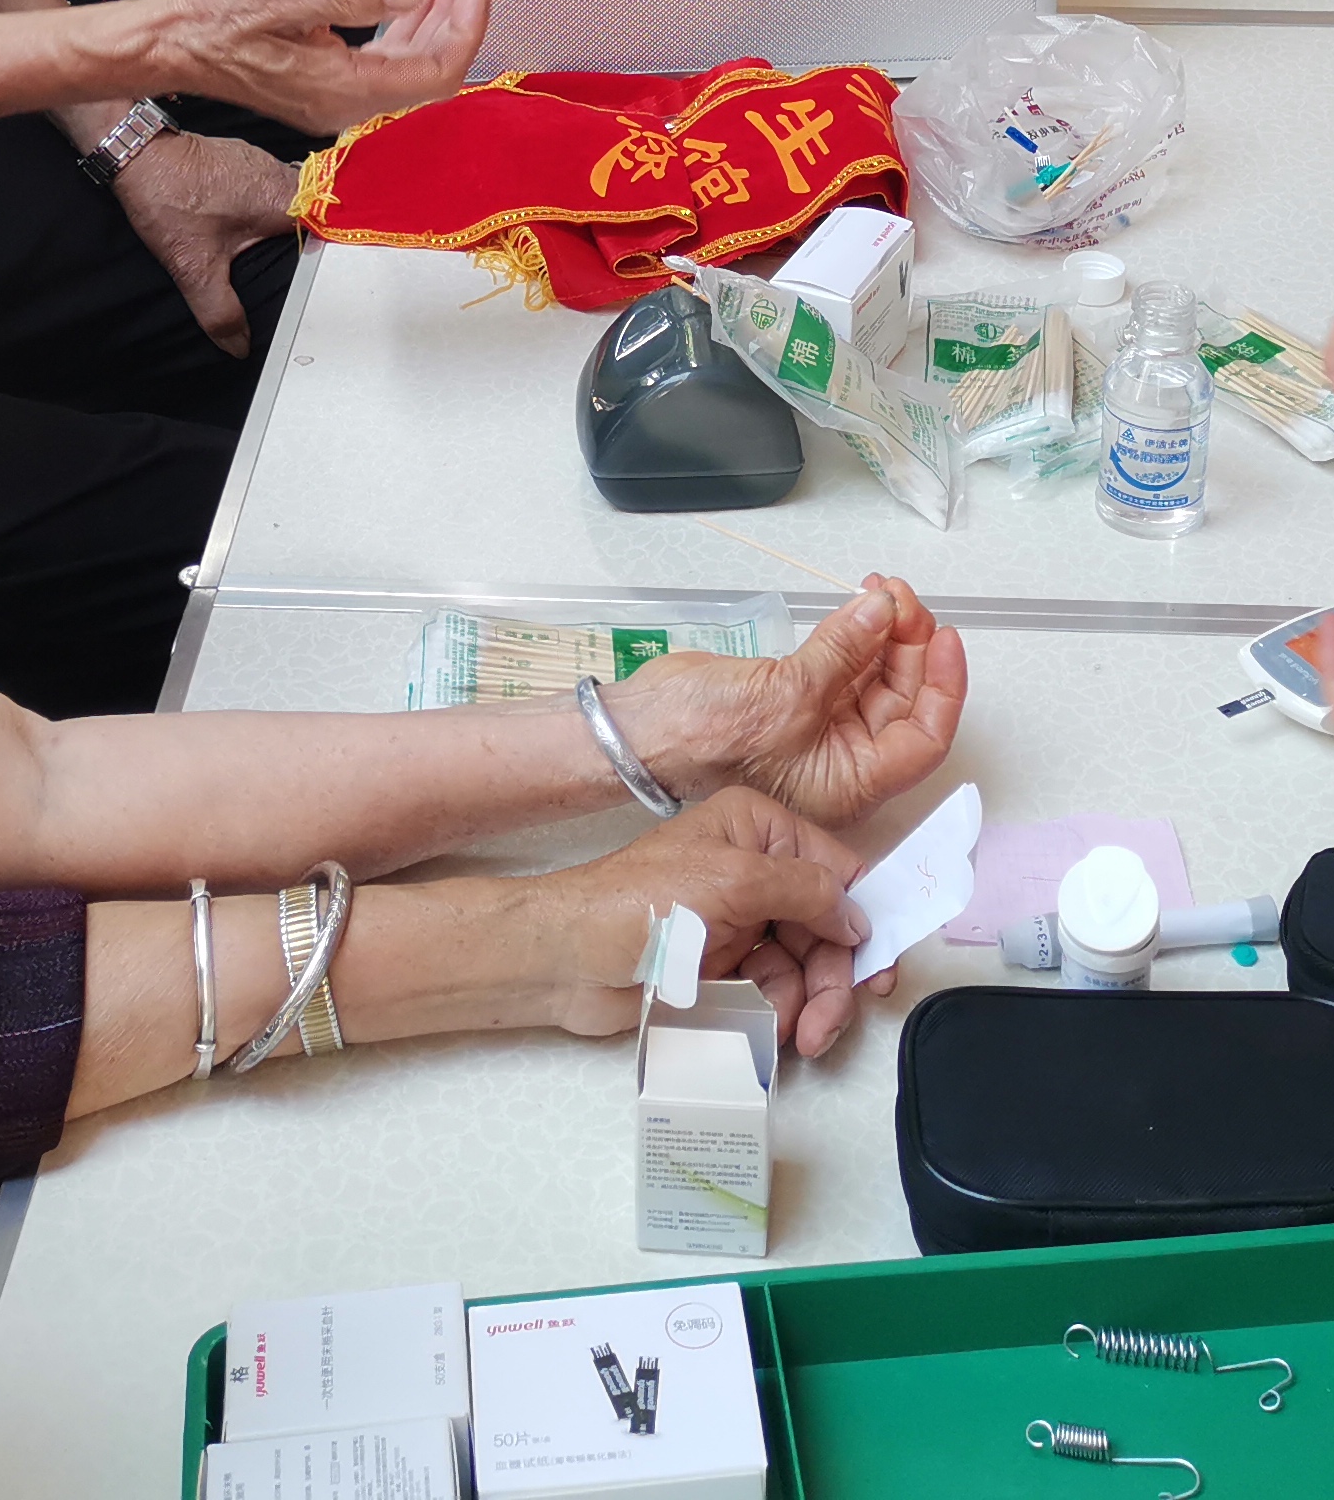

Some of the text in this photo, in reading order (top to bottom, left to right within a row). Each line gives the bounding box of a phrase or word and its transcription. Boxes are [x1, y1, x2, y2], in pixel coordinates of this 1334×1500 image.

[590, 115, 679, 198] 您
[486, 1318, 544, 1337] yuwell
[672, 1317, 716, 1333] 免调码
[230, 1366, 249, 1384] 格
[254, 1355, 268, 1398] yuwell
[493, 1431, 531, 1448] 50片
